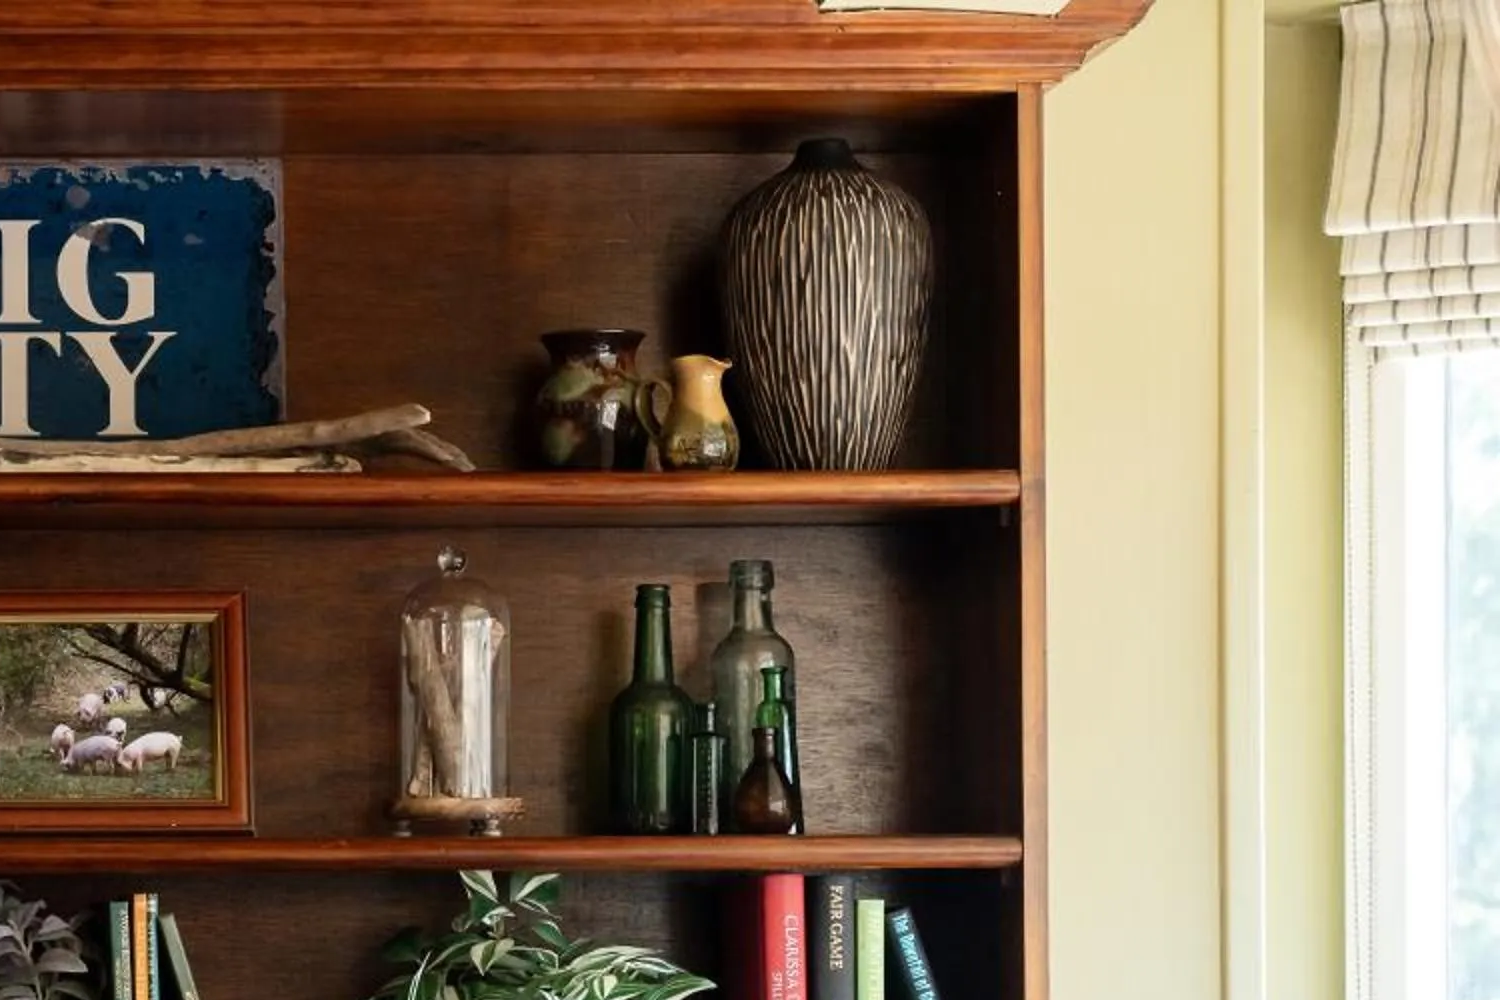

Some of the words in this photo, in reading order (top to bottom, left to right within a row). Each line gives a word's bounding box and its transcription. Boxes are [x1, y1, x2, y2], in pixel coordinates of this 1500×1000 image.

[830, 885, 843, 921] FAIR
[784, 915, 800, 989] CLARISSA
[830, 923, 844, 970] GAME
